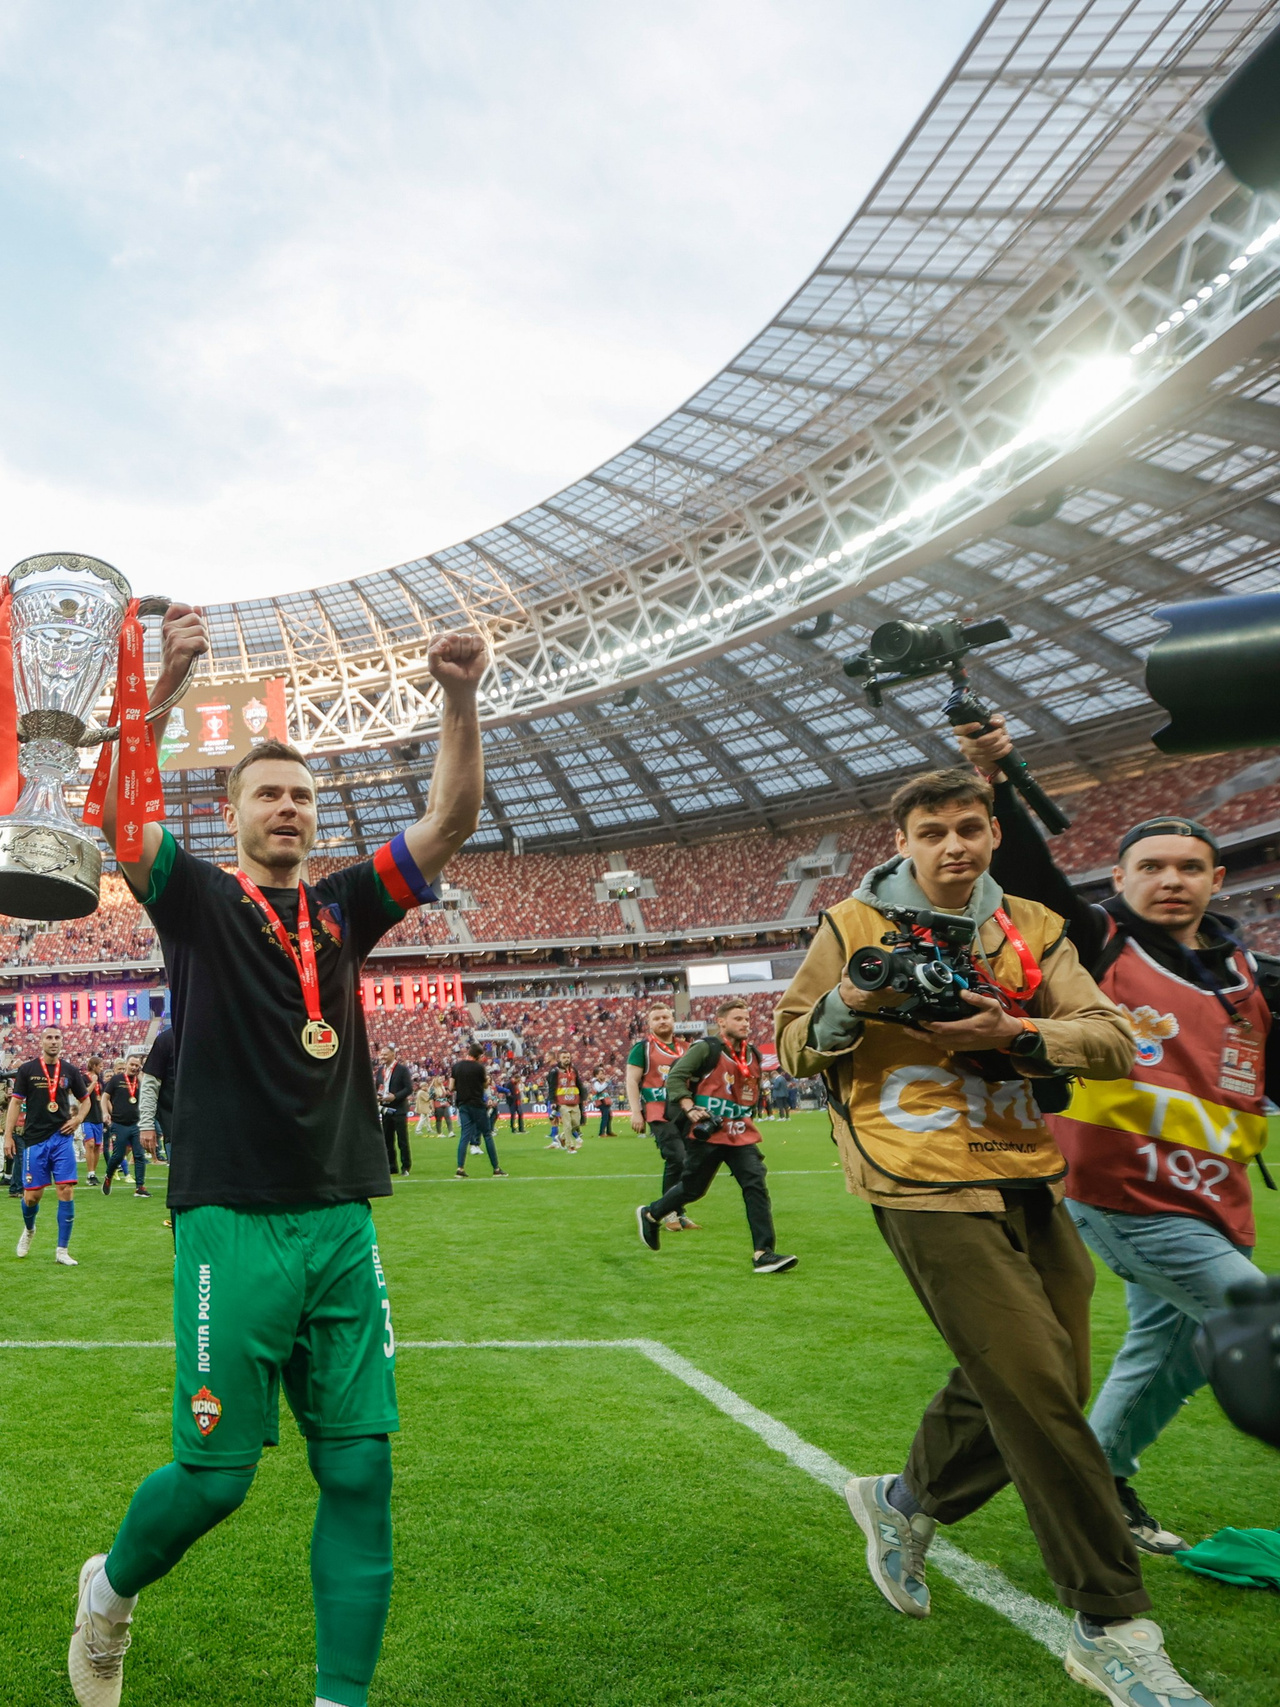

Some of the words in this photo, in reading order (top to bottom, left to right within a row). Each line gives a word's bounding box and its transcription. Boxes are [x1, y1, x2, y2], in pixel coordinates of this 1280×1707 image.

[87, 807, 100, 815] BET
[146, 799, 160, 807] FON
[146, 805, 160, 813] BET
[1133, 1081, 1240, 1154] TV
[1136, 1142, 1230, 1202] 192
[198, 1264, 211, 1320] РОССИИ
[198, 1325, 210, 1372] ПОЧТА
[192, 1400, 220, 1416] ЦСКА
[878, 1521, 902, 1547] N
[1103, 1657, 1135, 1685] N
